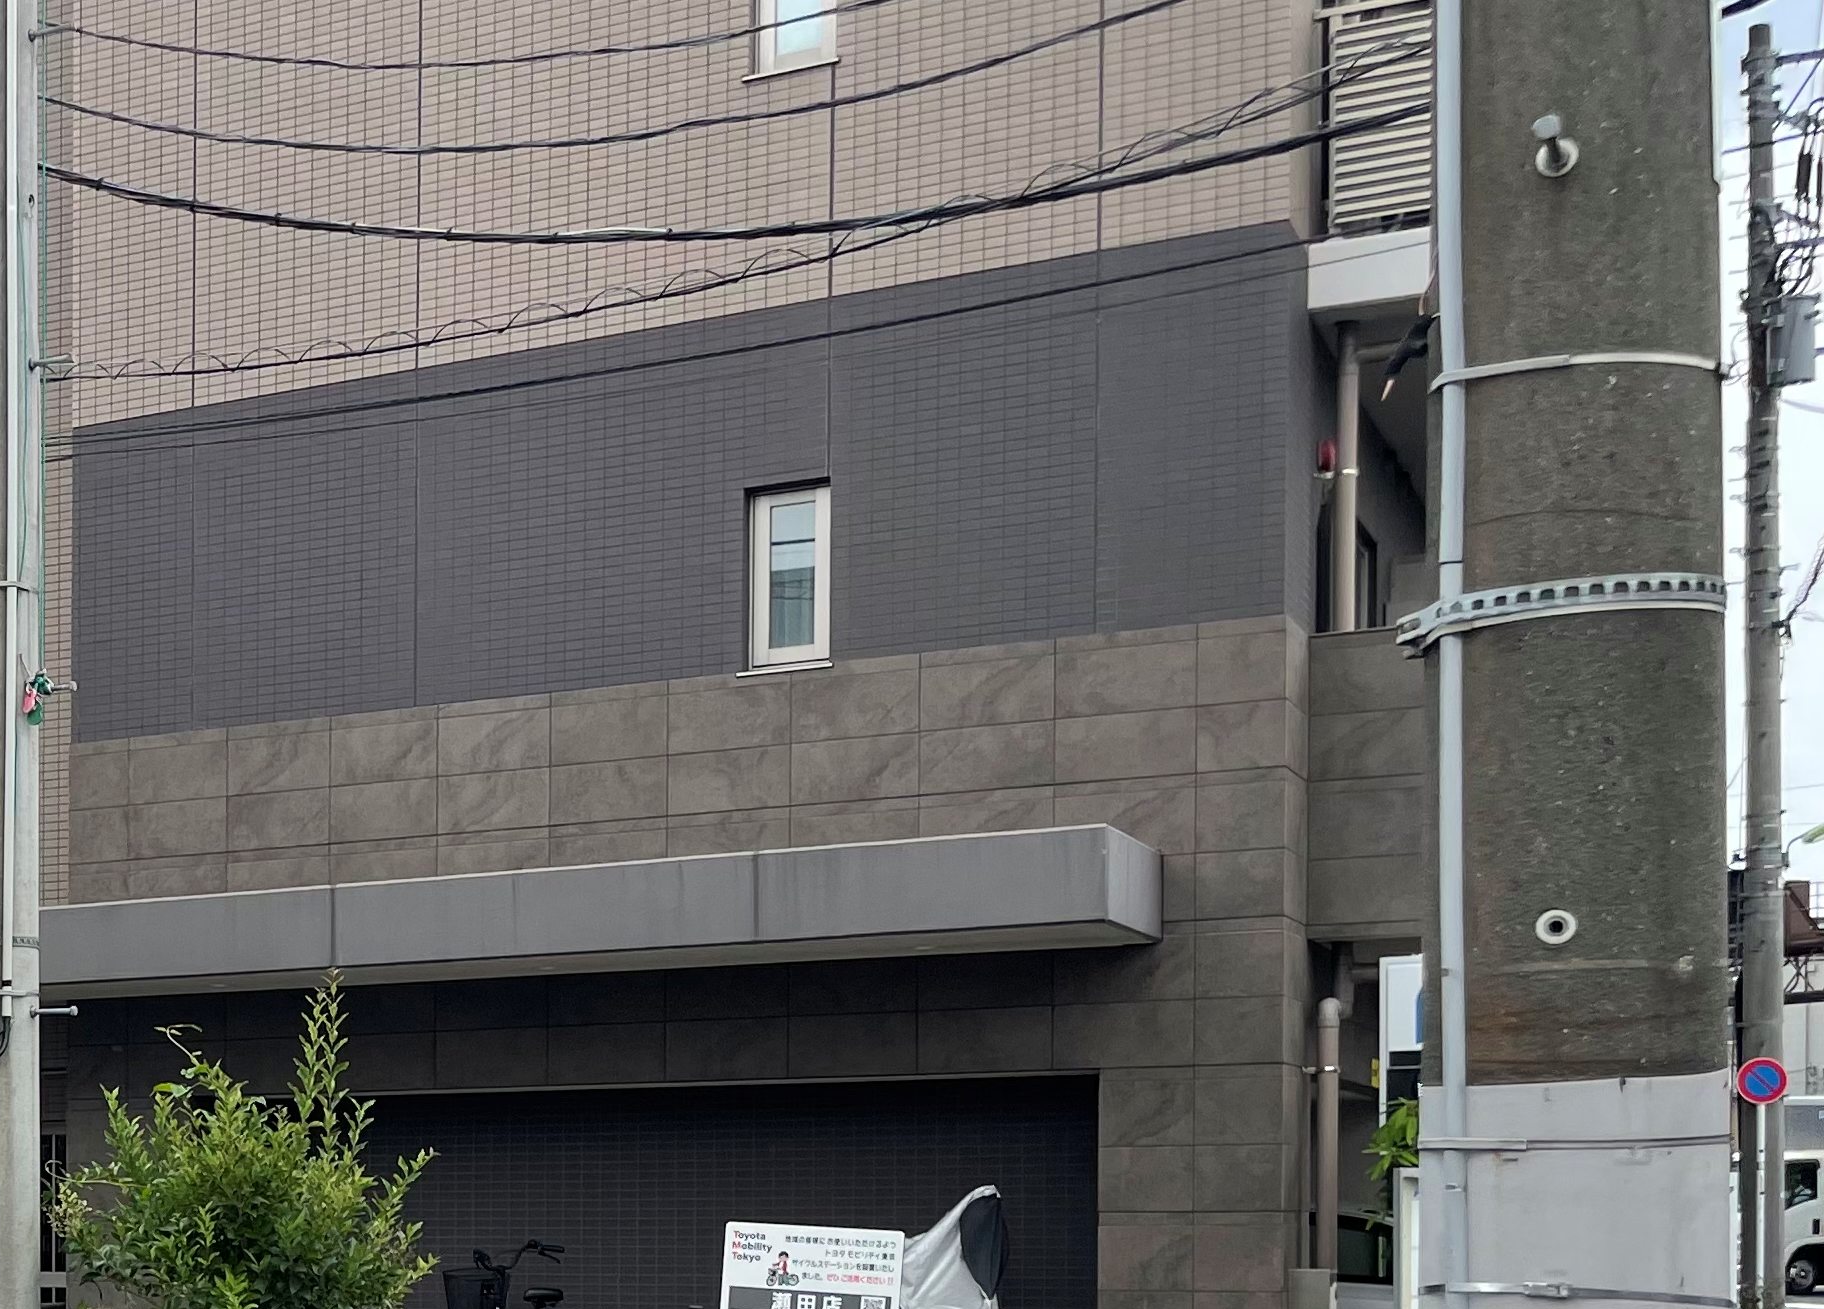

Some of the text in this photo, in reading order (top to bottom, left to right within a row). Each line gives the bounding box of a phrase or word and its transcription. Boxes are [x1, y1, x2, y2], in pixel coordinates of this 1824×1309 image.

[733, 1230, 766, 1241] Toyota
[732, 1241, 772, 1253] Mobility
[732, 1251, 761, 1263] Tokyo
